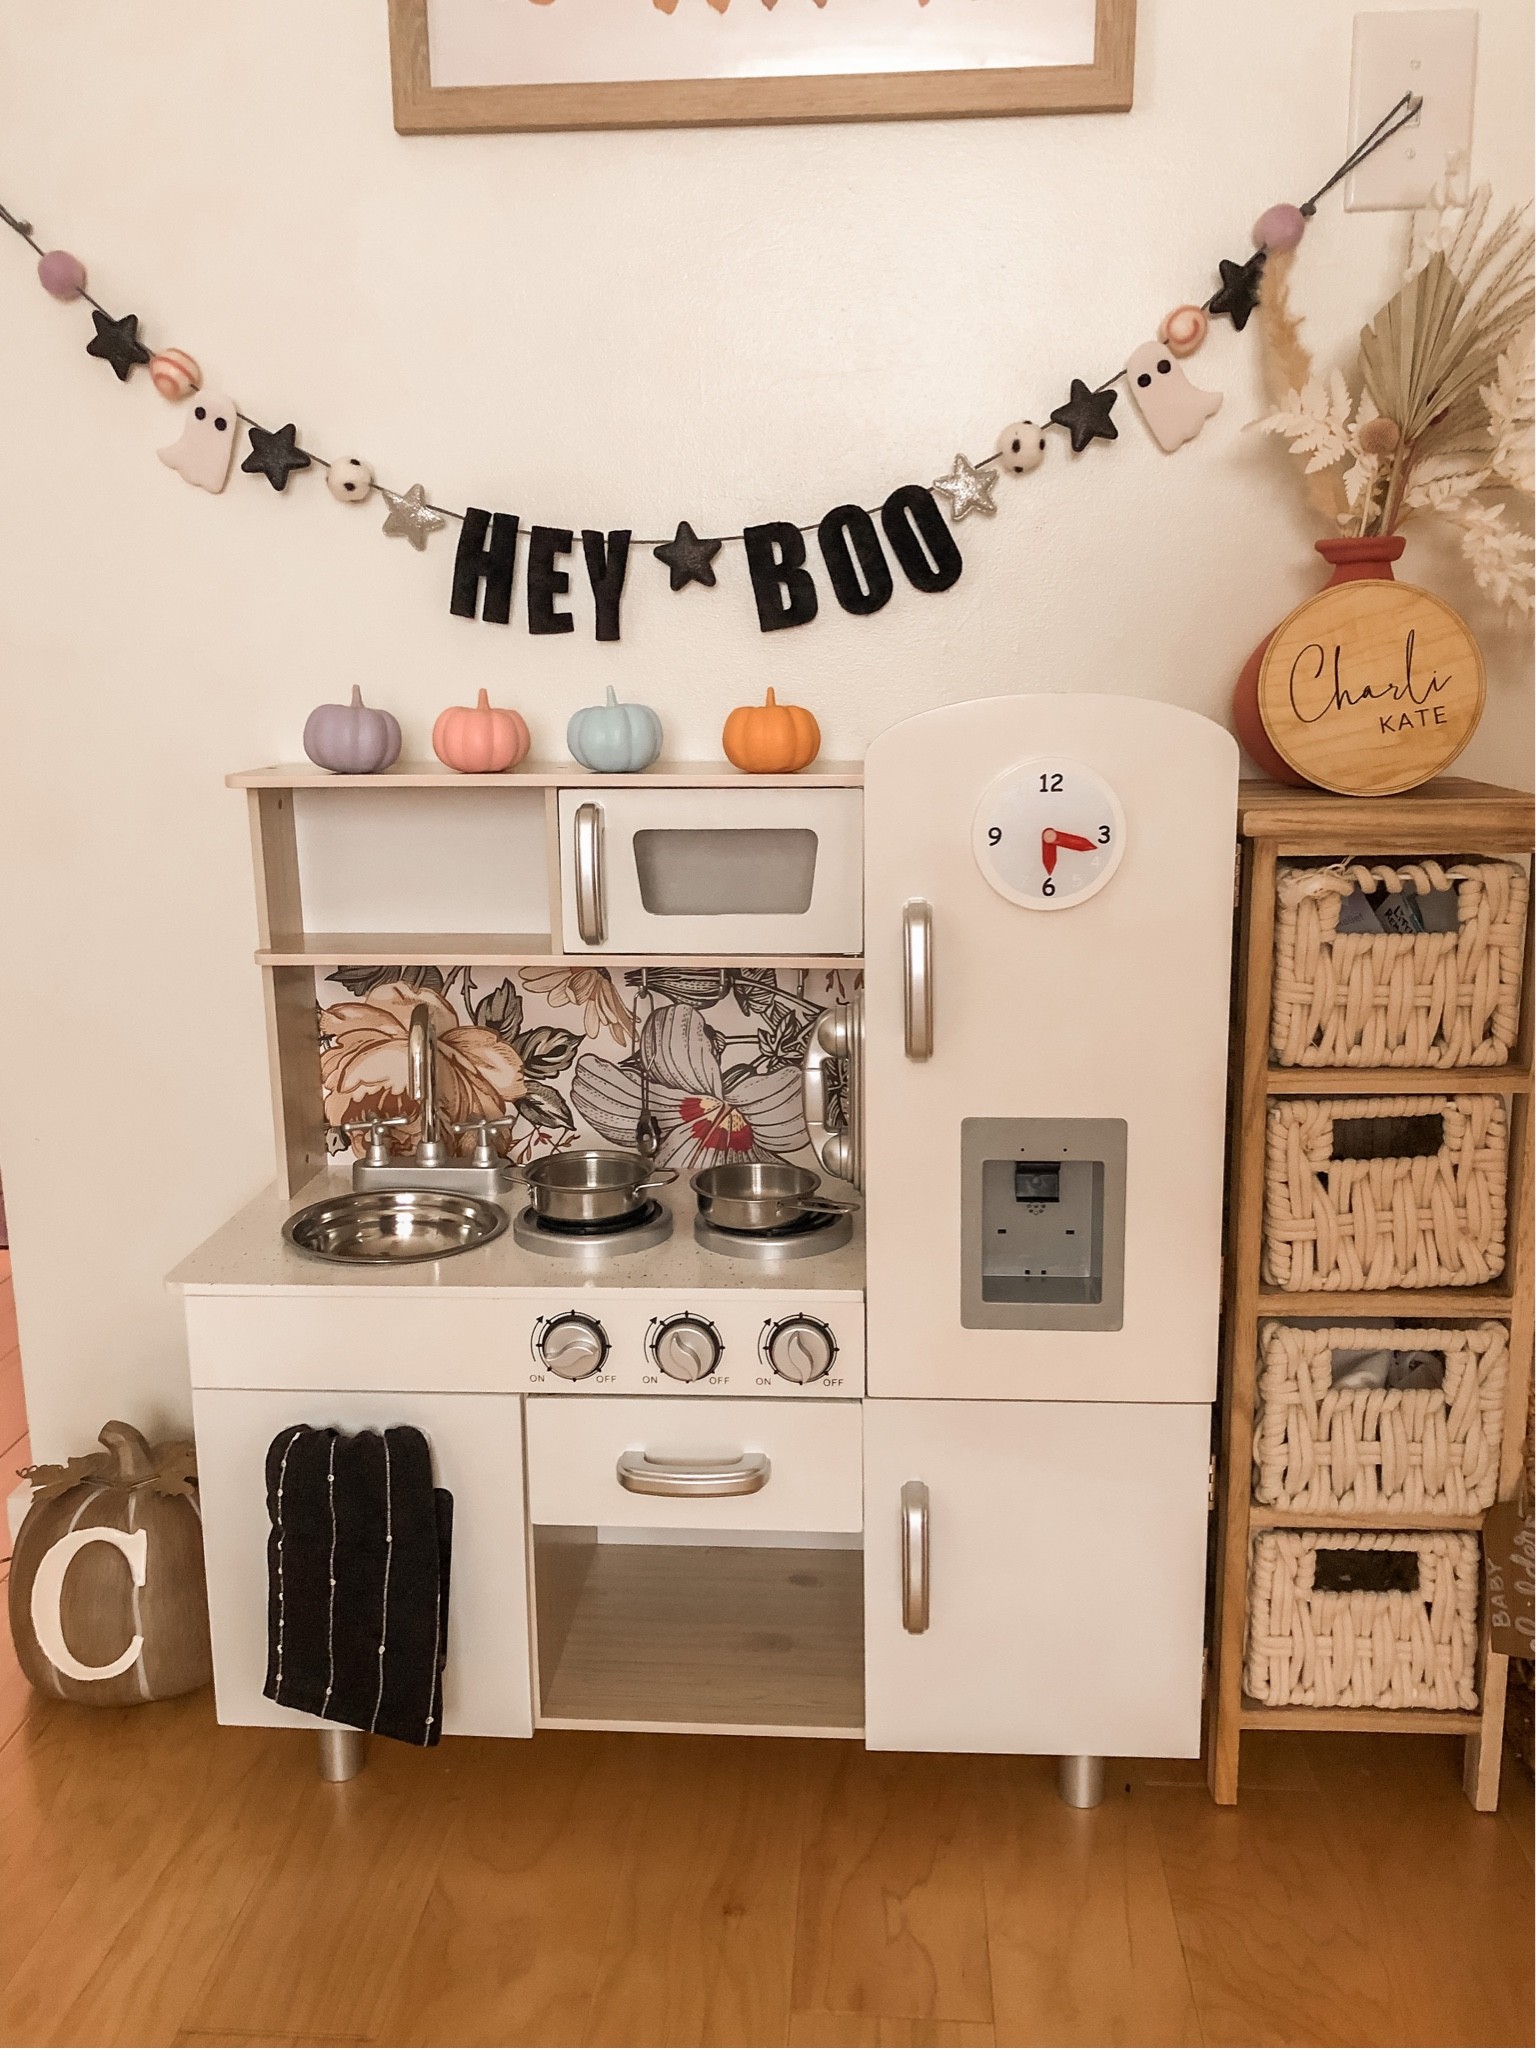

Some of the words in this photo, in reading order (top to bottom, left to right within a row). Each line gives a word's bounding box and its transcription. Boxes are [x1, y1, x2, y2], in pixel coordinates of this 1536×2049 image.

[449, 507, 632, 642] HEY
[743, 484, 963, 633] BOO
[1289, 629, 1453, 723] Charli
[1379, 705, 1448, 734] KATE
[1039, 773, 1064, 793] 12
[988, 827, 1002, 847] 9
[1097, 825, 1111, 844] 3
[1042, 877, 1056, 897] 6
[529, 1374, 545, 1383] ON
[596, 1375, 617, 1384] OFF
[642, 1375, 658, 1384] ON
[709, 1376, 730, 1385] OFF
[755, 1377, 772, 1386] ON
[823, 1378, 844, 1387] OFF
[1486, 1557, 1511, 1628] BABY
[31, 1526, 147, 1680] C
